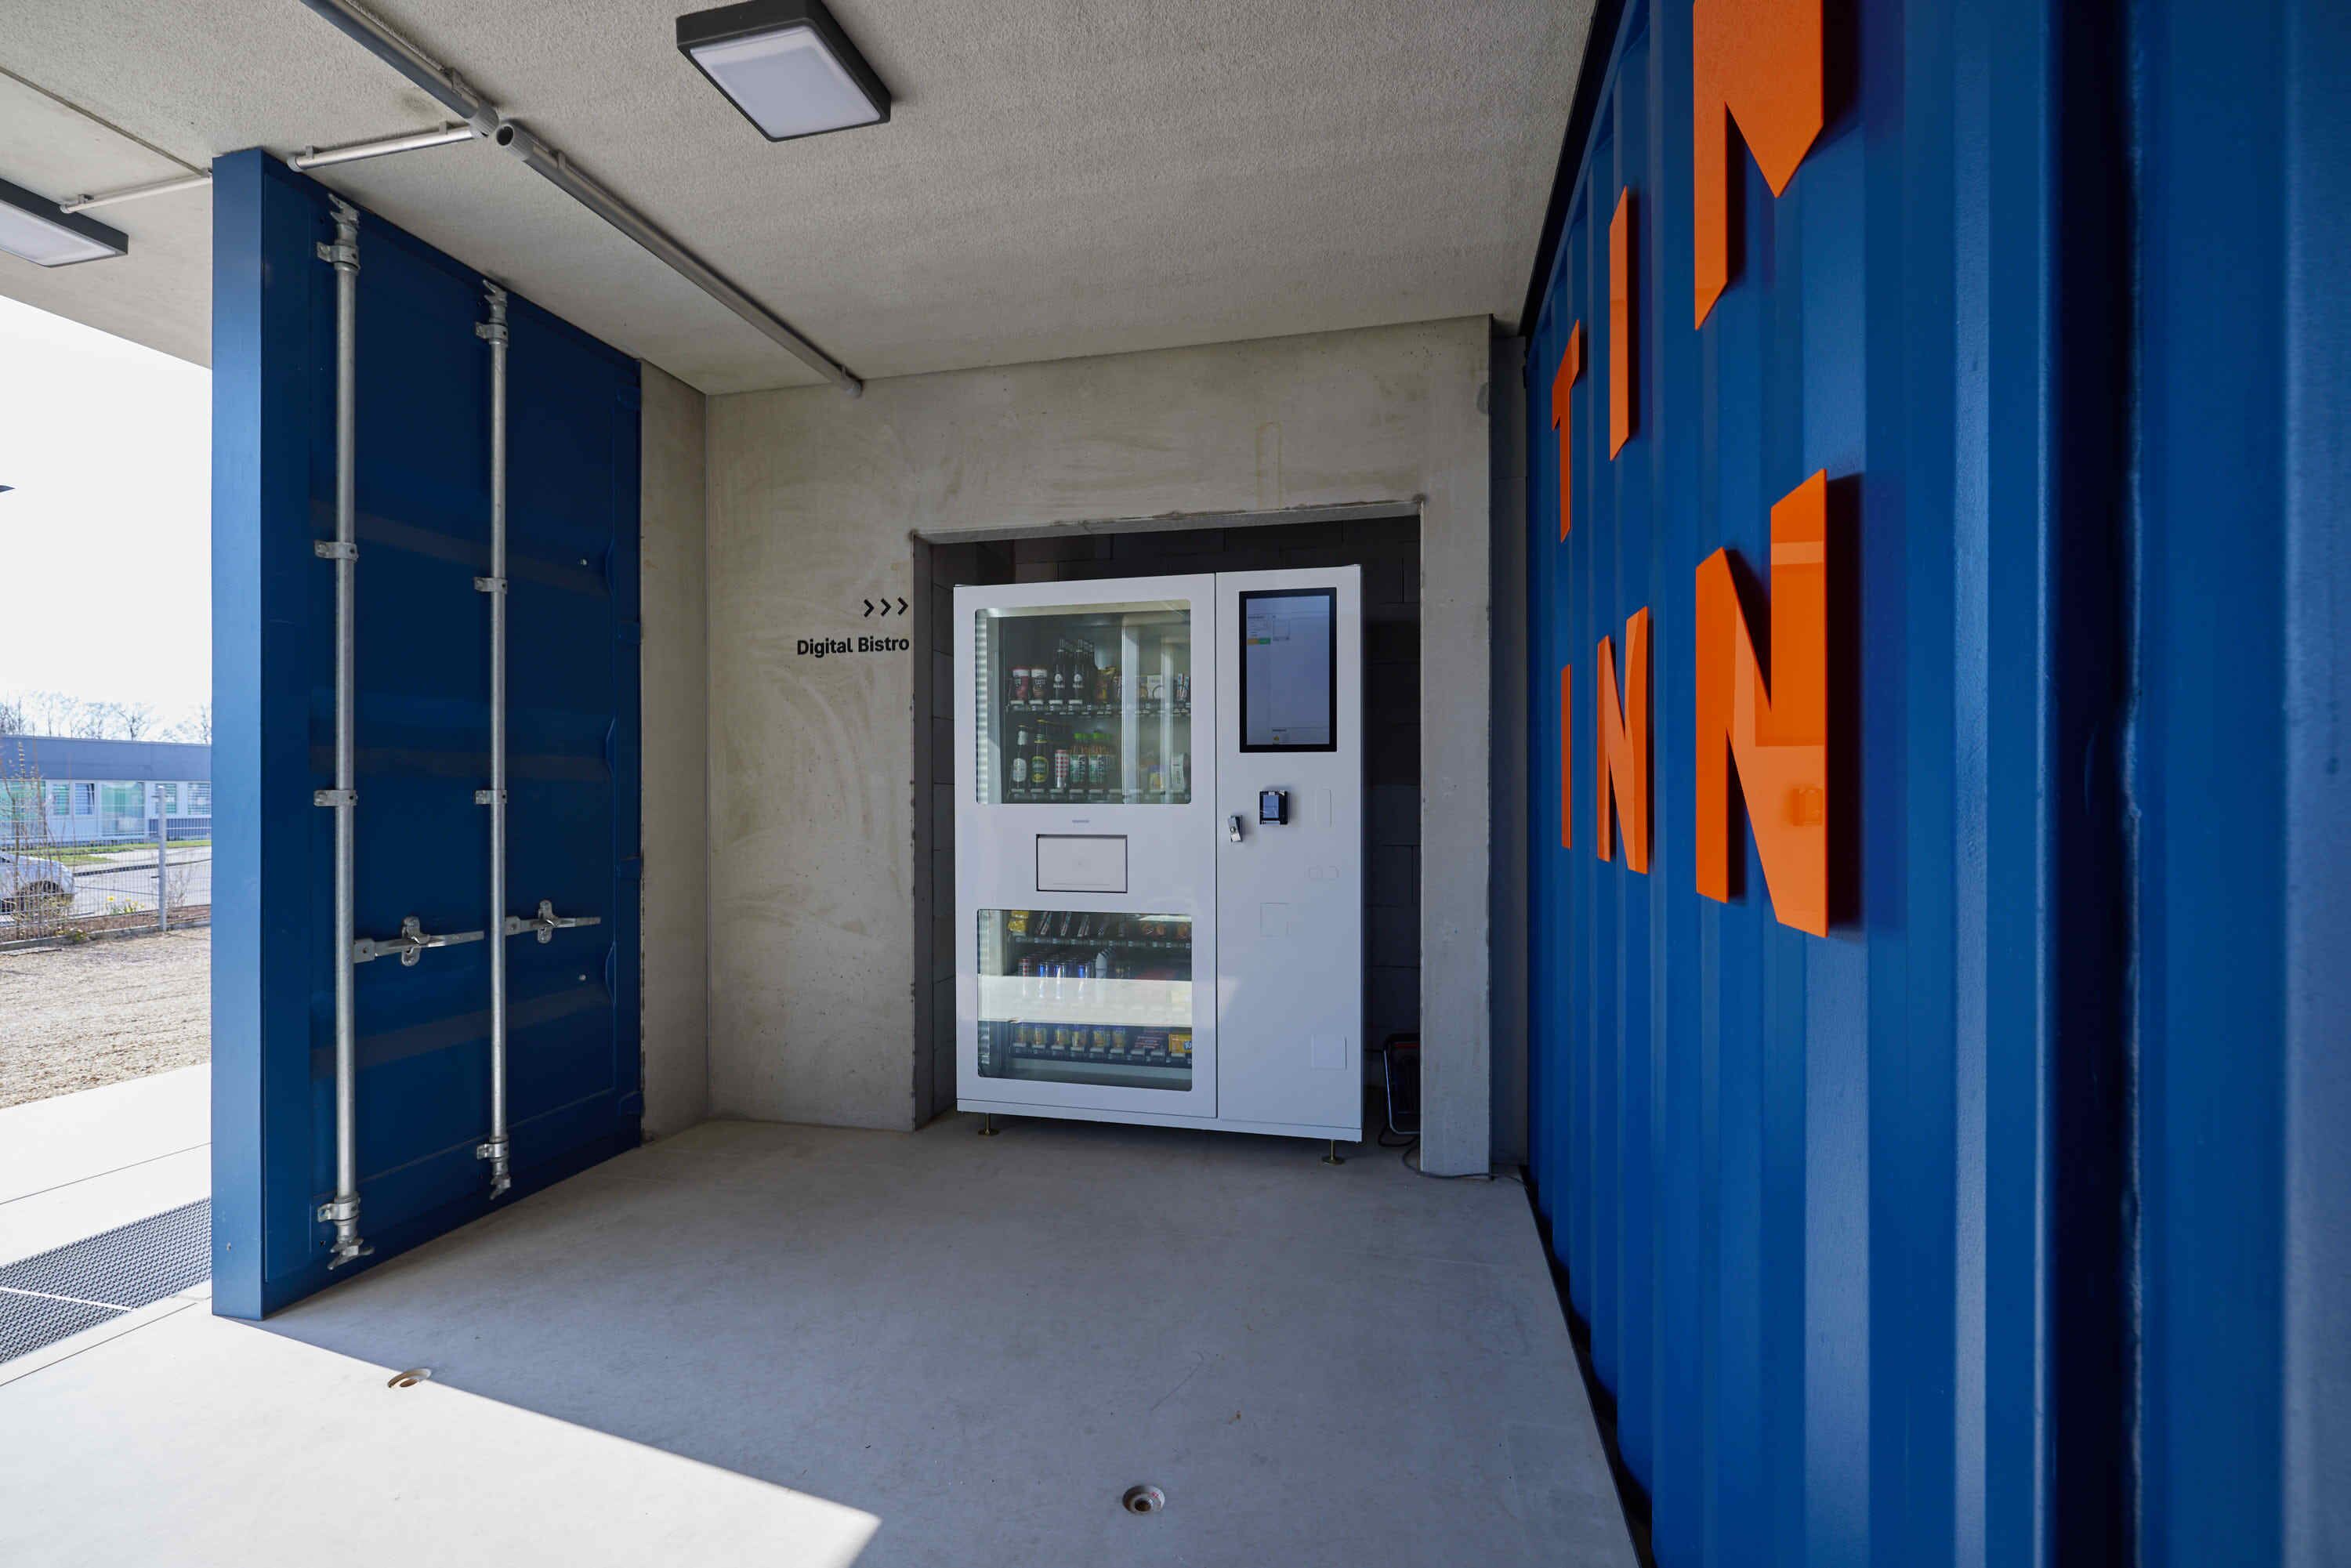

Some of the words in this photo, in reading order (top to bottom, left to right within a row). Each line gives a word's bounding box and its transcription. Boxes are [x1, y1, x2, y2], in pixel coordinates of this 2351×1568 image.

[797, 638, 853, 658] Digital
[858, 636, 910, 653] Bistro
[1560, 467, 1827, 938] INN
